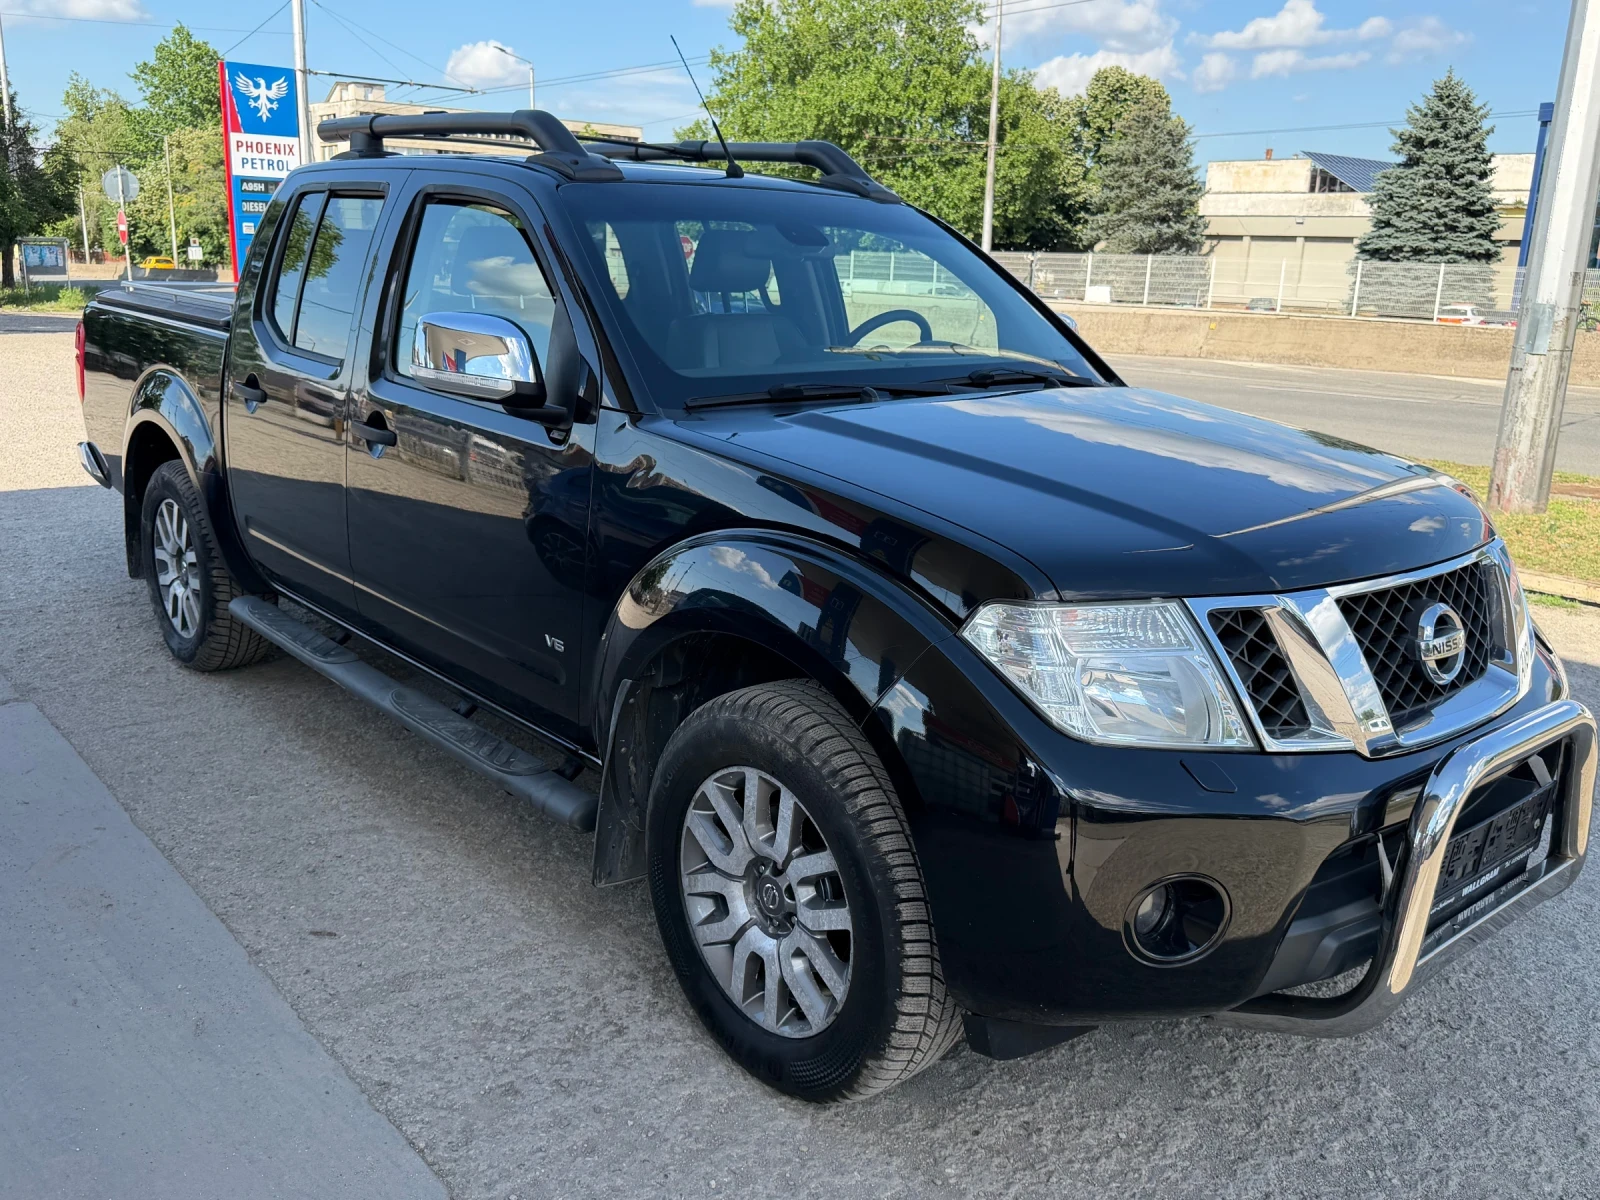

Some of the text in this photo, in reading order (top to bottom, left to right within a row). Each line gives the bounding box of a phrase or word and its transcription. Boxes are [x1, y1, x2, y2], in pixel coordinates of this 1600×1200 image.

[236, 140, 295, 156] PHOENIX
[241, 157, 292, 172] PETROL
[242, 181, 265, 192] A95H
[545, 633, 565, 653] V6
[1432, 635, 1461, 656] NISS
